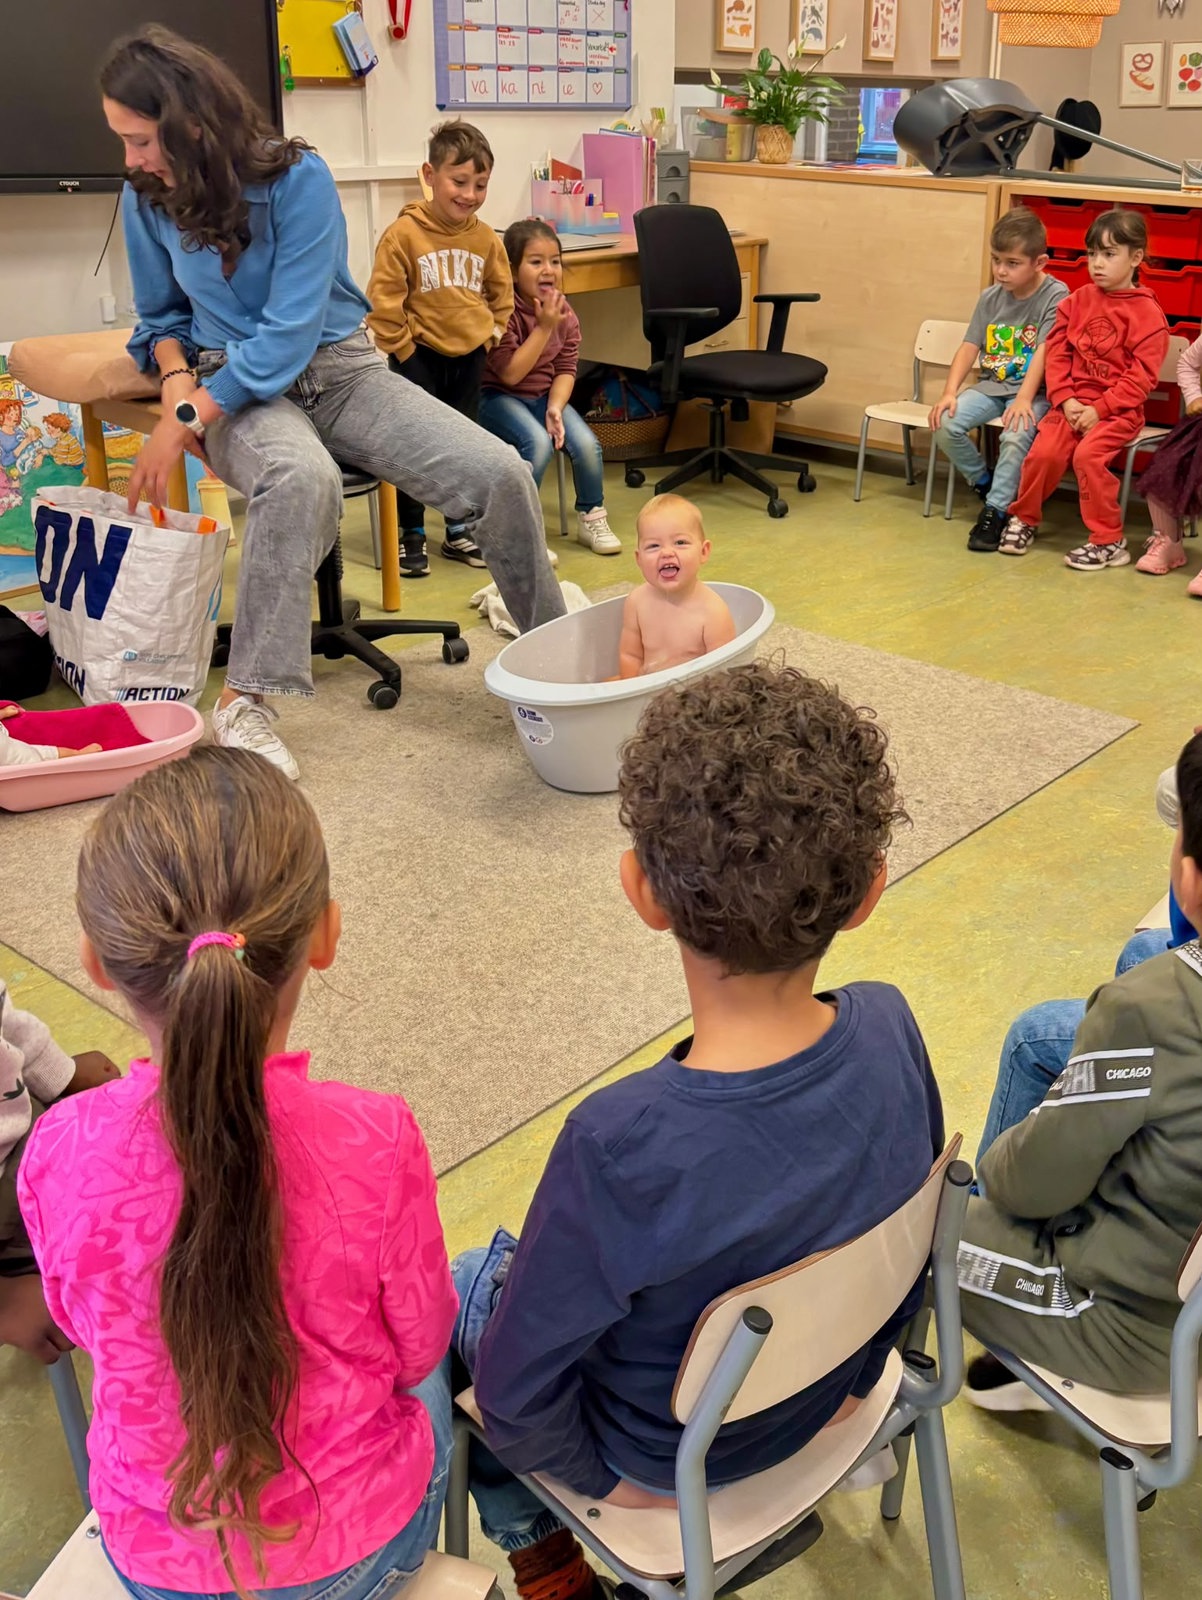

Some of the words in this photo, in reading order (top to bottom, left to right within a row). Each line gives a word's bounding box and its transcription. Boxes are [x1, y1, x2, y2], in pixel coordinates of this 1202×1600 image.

[471, 79, 489, 95] va
[500, 80, 519, 95] ka
[417, 248, 485, 293] NIKE
[34, 505, 134, 621] ON
[124, 687, 190, 701] ACTION
[1105, 1066, 1152, 1080] CHICAGO
[1015, 1278, 1045, 1297] CHICAGO
